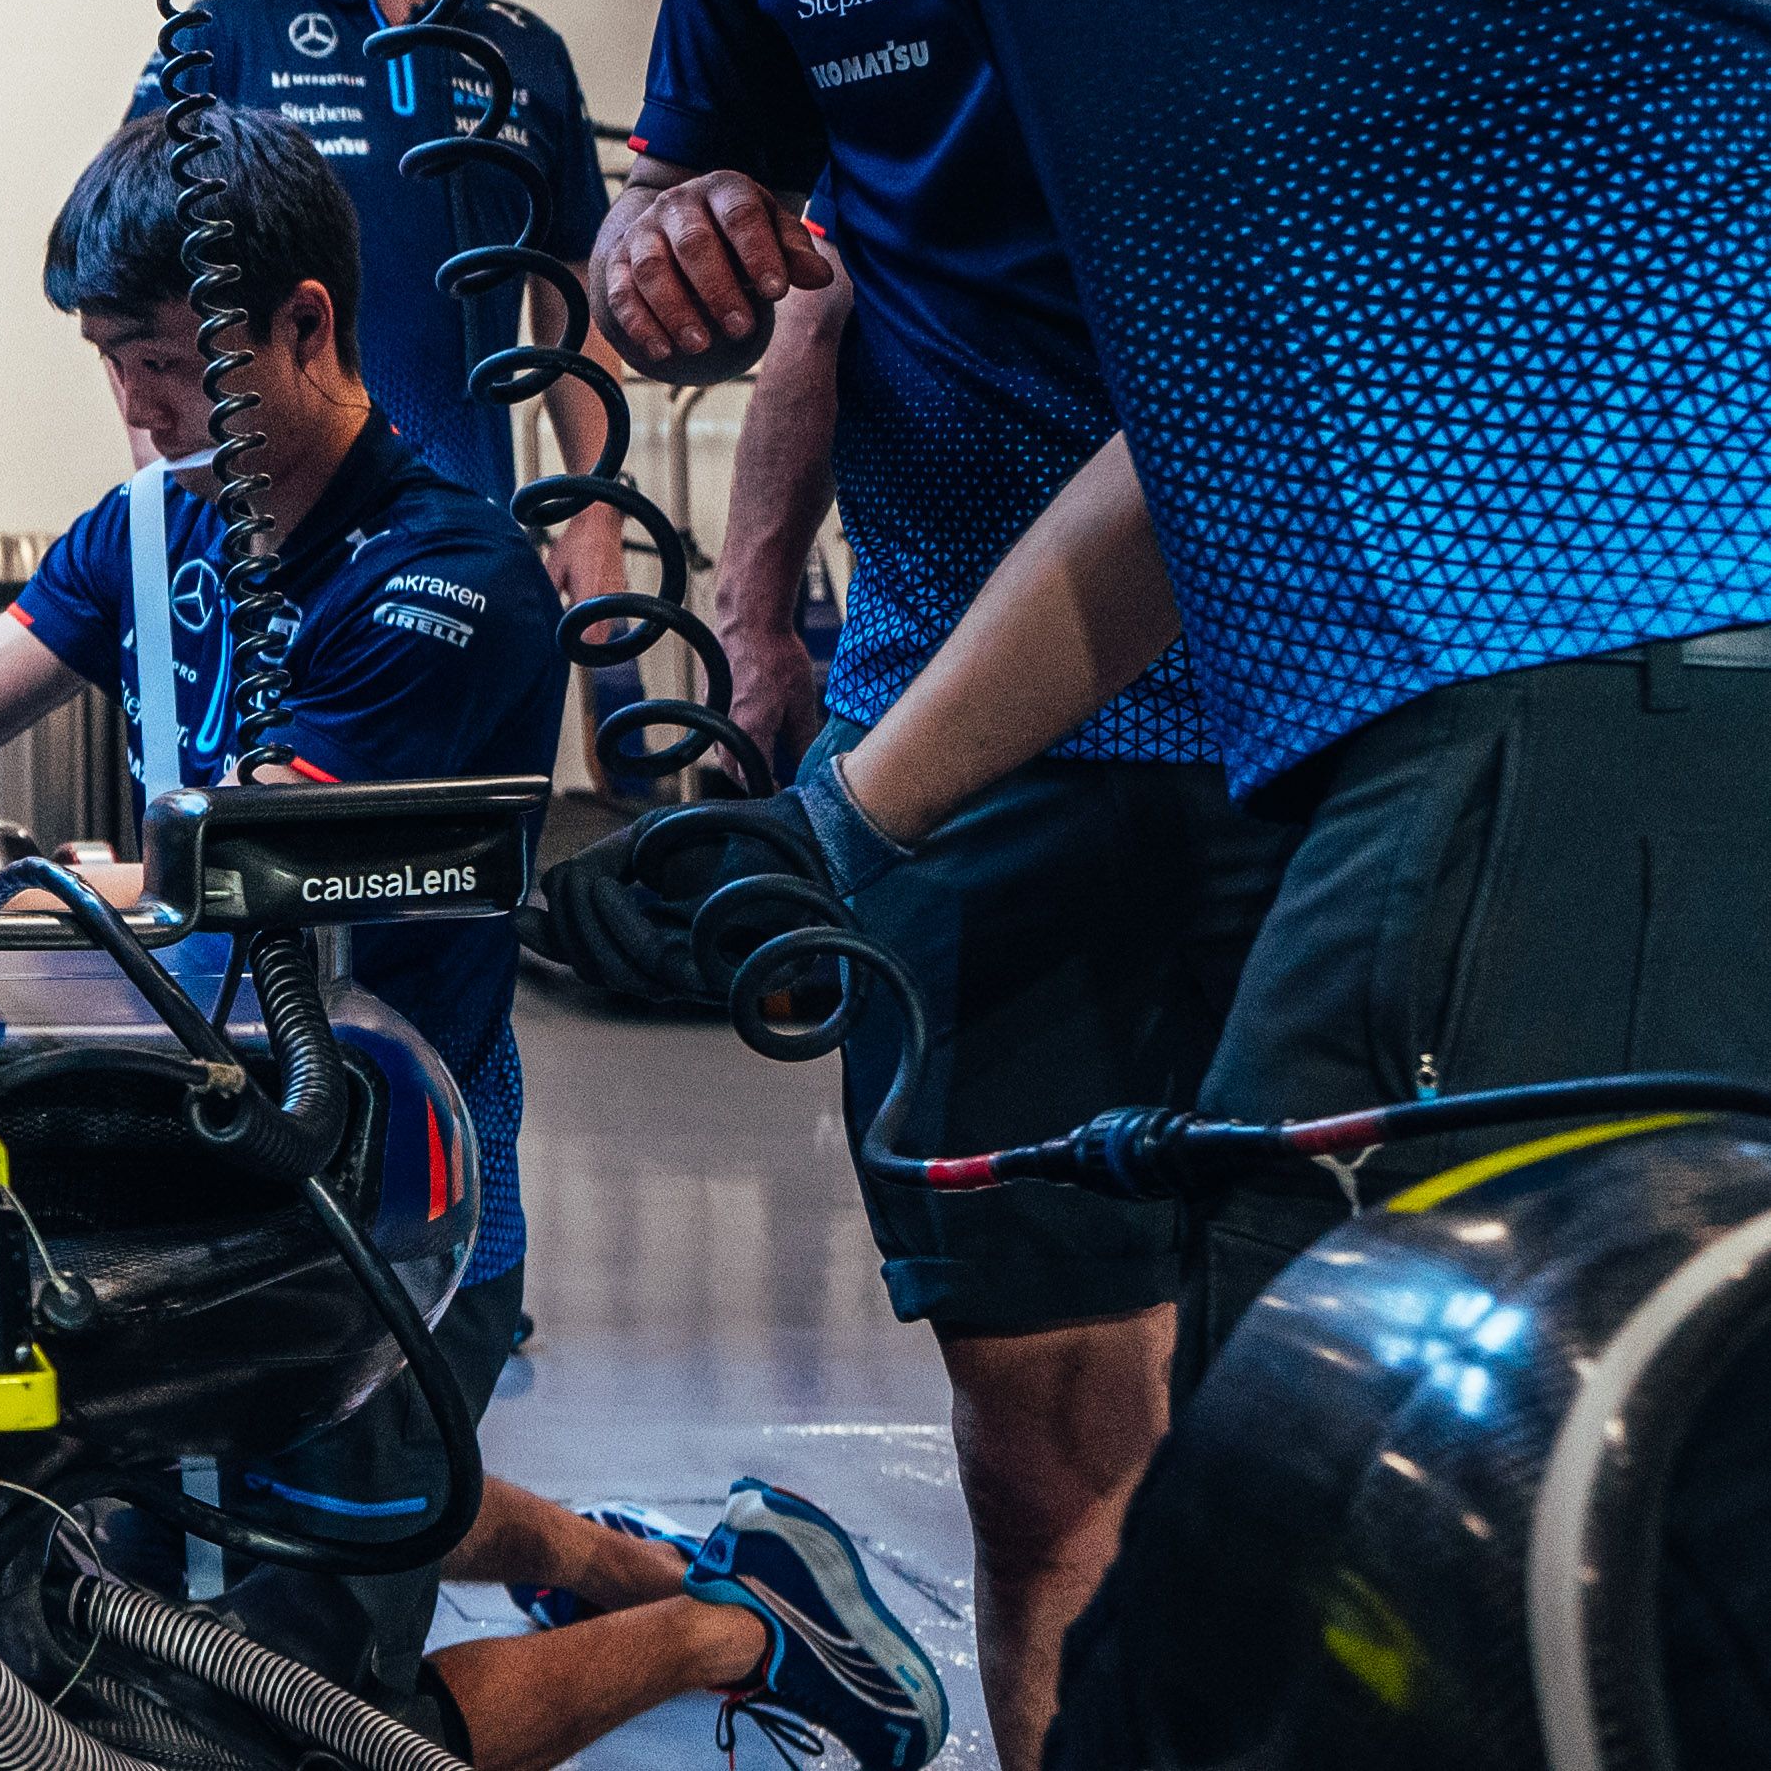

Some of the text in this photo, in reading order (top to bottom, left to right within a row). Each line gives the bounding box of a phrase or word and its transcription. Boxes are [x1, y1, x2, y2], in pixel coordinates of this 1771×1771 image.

[810, 39, 930, 89] KOMATSU
[405, 574, 487, 613] kraken
[302, 864, 477, 902] causaLens
